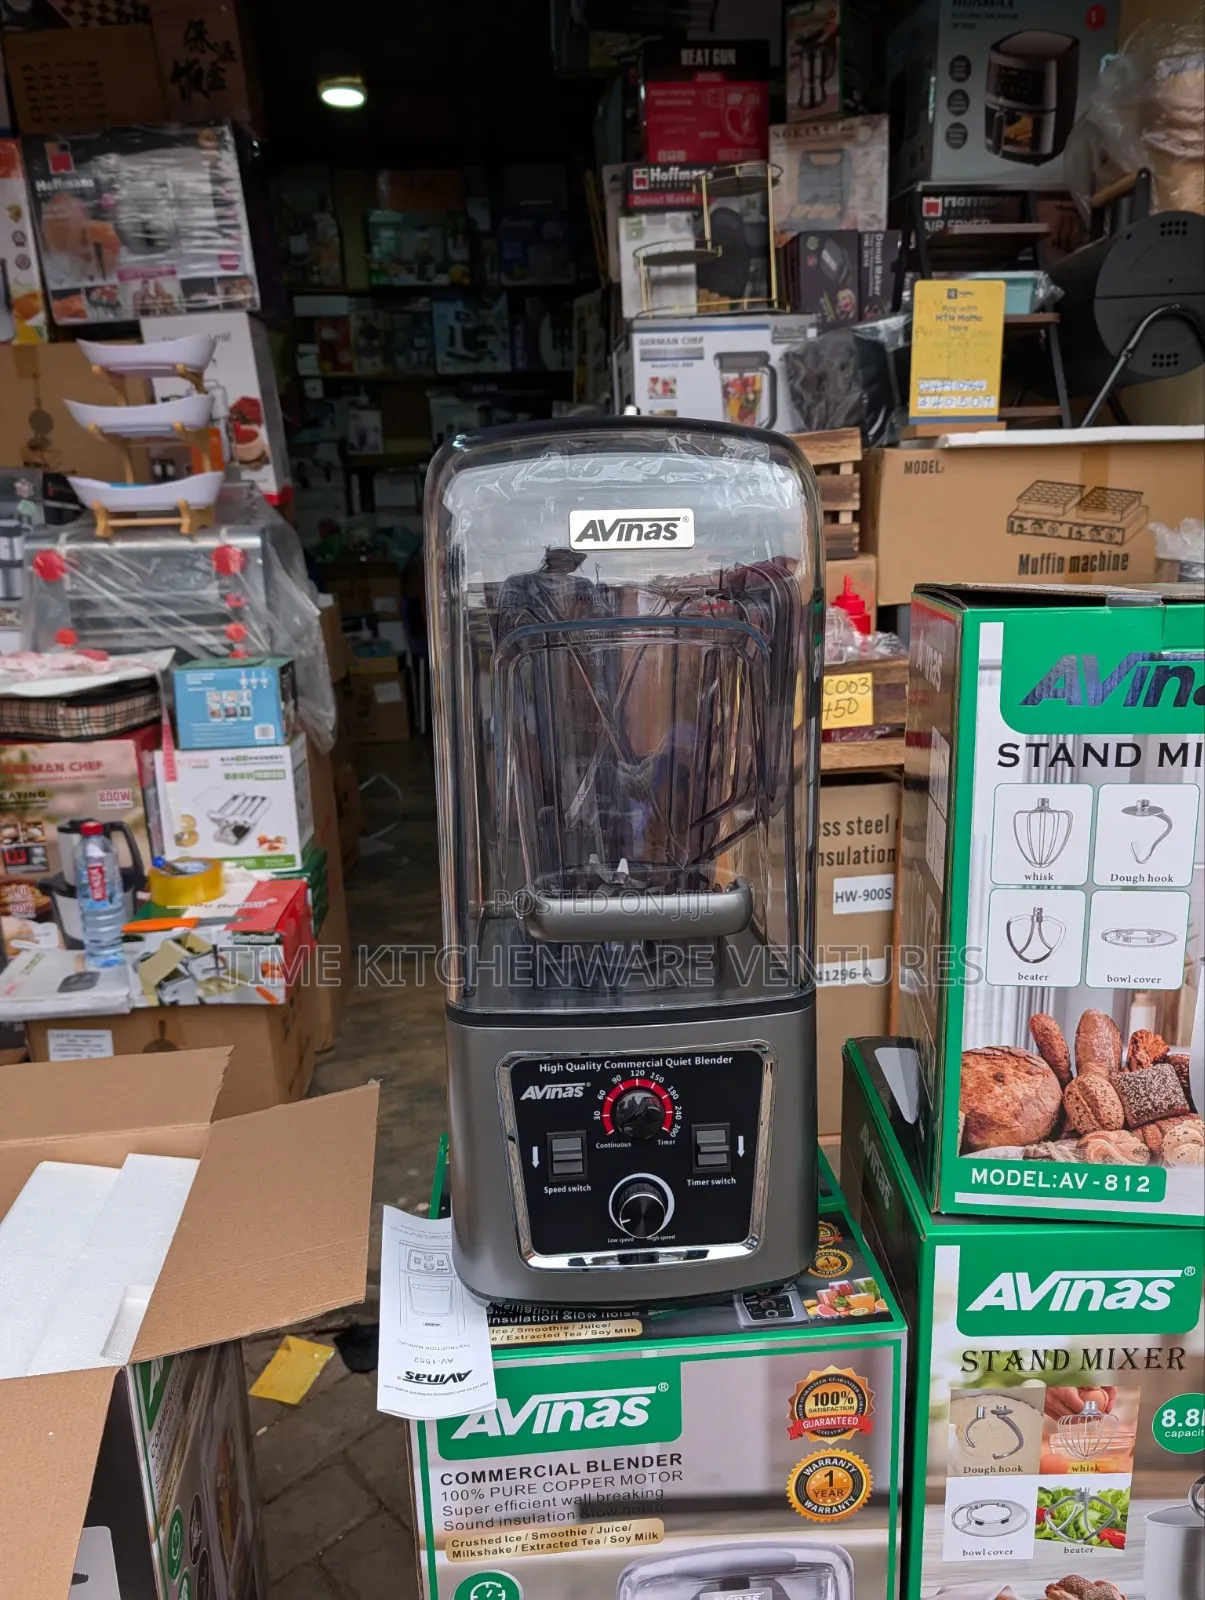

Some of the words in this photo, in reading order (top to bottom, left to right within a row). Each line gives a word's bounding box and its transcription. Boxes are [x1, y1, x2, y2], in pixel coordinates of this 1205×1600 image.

[712, 48, 736, 66] GUN
[681, 336, 704, 345] CHEF
[1018, 552, 1064, 575] Muffin
[1069, 551, 1129, 573] machine
[1018, 652, 1205, 708] AVin
[997, 742, 1142, 768] STAND
[69, 760, 104, 772] CHEF
[846, 814, 890, 835] steel
[818, 845, 897, 866] nsulation
[1024, 871, 1054, 881] whisk
[1110, 873, 1145, 884] Dough
[1147, 873, 1174, 883] hook
[835, 887, 892, 904] HW-900S
[1017, 972, 1050, 982] beater
[1107, 974, 1132, 984] bowl
[1133, 976, 1162, 984] cover
[539, 1062, 564, 1075] High
[566, 1061, 602, 1073] Quality
[604, 1058, 663, 1069] Commercial
[665, 1057, 692, 1068] Quiet
[694, 1055, 733, 1066] Blender
[611, 1074, 622, 1085] 90
[630, 1069, 645, 1077] 120
[649, 1072, 665, 1083] 150
[597, 1089, 606, 1100] 60
[667, 1085, 680, 1100] 180
[593, 1110, 601, 1121] 30
[674, 1105, 682, 1121] 240
[669, 1122, 682, 1138] 300
[595, 1141, 632, 1149] Continuous
[687, 1178, 710, 1187] Timer
[711, 1176, 737, 1185] switch
[543, 1185, 565, 1195] Speed
[566, 1184, 592, 1193] switch
[965, 1269, 1183, 1312] AVinas
[488, 1313, 558, 1324] insulation
[517, 1325, 569, 1333] Smoothie
[506, 1332, 560, 1341] Extracted
[413, 1356, 454, 1365] AV-1552
[960, 1348, 1070, 1373] STAND
[1080, 1346, 1187, 1372] MIXER
[812, 1390, 854, 1407] 100%
[808, 1404, 855, 1414] SATISFACTION
[802, 1416, 859, 1430] GUARANTEED
[440, 1462, 581, 1486] COMMERCIAL
[586, 1452, 683, 1474] BLENDER
[803, 1458, 858, 1476] WARRANTY
[963, 1464, 997, 1475] Dough
[998, 1463, 1024, 1473] hook
[1071, 1463, 1101, 1473] whisk
[824, 1469, 834, 1488] 1
[441, 1485, 485, 1503] 100%
[490, 1482, 538, 1499] PURE
[542, 1476, 616, 1494] COPPER
[620, 1469, 684, 1487] MOTOR
[813, 1489, 845, 1498] YEAR
[442, 1502, 490, 1519] Super
[494, 1495, 557, 1513] efficient
[561, 1493, 592, 1507] wall
[596, 1487, 664, 1504] breaking
[803, 1495, 857, 1514] WARRANTY
[443, 1516, 494, 1532] Sound
[498, 1510, 576, 1527] insulation
[451, 1535, 502, 1549] Crushed
[504, 1533, 522, 1544] Ice
[531, 1527, 588, 1541] Smoothie
[452, 1545, 512, 1560] Milkshake
[521, 1539, 578, 1553] Extracted
[581, 1536, 600, 1547] Tea
[609, 1533, 631, 1546] Soy
[634, 1531, 659, 1543] Milk
[962, 1547, 988, 1557] bowl
[988, 1548, 1014, 1557] cover
[1063, 1545, 1095, 1555] beater
